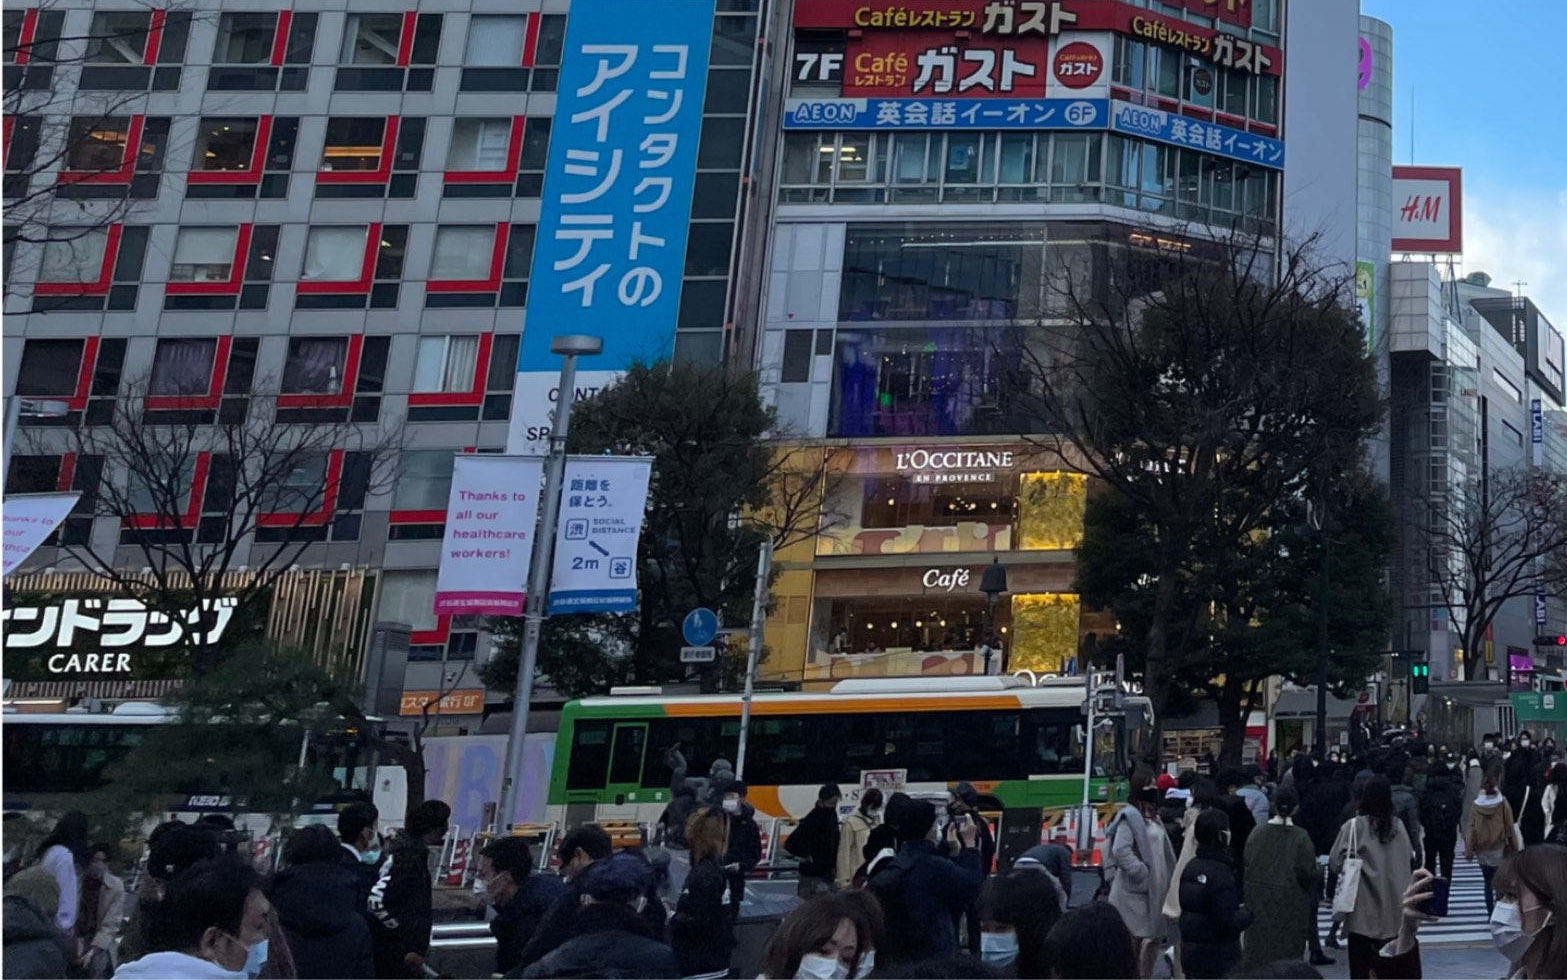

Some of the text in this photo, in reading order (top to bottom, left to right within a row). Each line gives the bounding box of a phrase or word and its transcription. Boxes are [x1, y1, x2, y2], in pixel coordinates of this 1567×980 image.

[981, 0, 1077, 35] ガスト
[855, 52, 908, 73] Café
[1213, 34, 1272, 75] ガスト
[796, 53, 844, 80] 7F
[914, 46, 1036, 94] ガスト
[1059, 62, 1098, 76] ガスト
[855, 74, 907, 87] レストラン
[797, 101, 1093, 126] AEON 英会話イーオン 6F
[1121, 108, 1282, 163] AEON 英会話イーオン
[553, 43, 640, 308] アイシティ
[617, 44, 690, 308] コンタクトの
[1400, 195, 1441, 223] H&M
[896, 449, 1014, 470] L'OCCITANE
[570, 479, 611, 492] 距離を
[935, 473, 992, 483] PROVENCE
[459, 490, 526, 502] Thanks to
[455, 510, 499, 520] all our
[452, 529, 526, 540] healthcare
[591, 526, 637, 535] DISTANCE
[451, 548, 511, 559] workers!
[571, 557, 600, 570] 2m
[613, 561, 628, 575] 谷
[923, 569, 970, 592] Café
[48, 653, 131, 673] CARER
